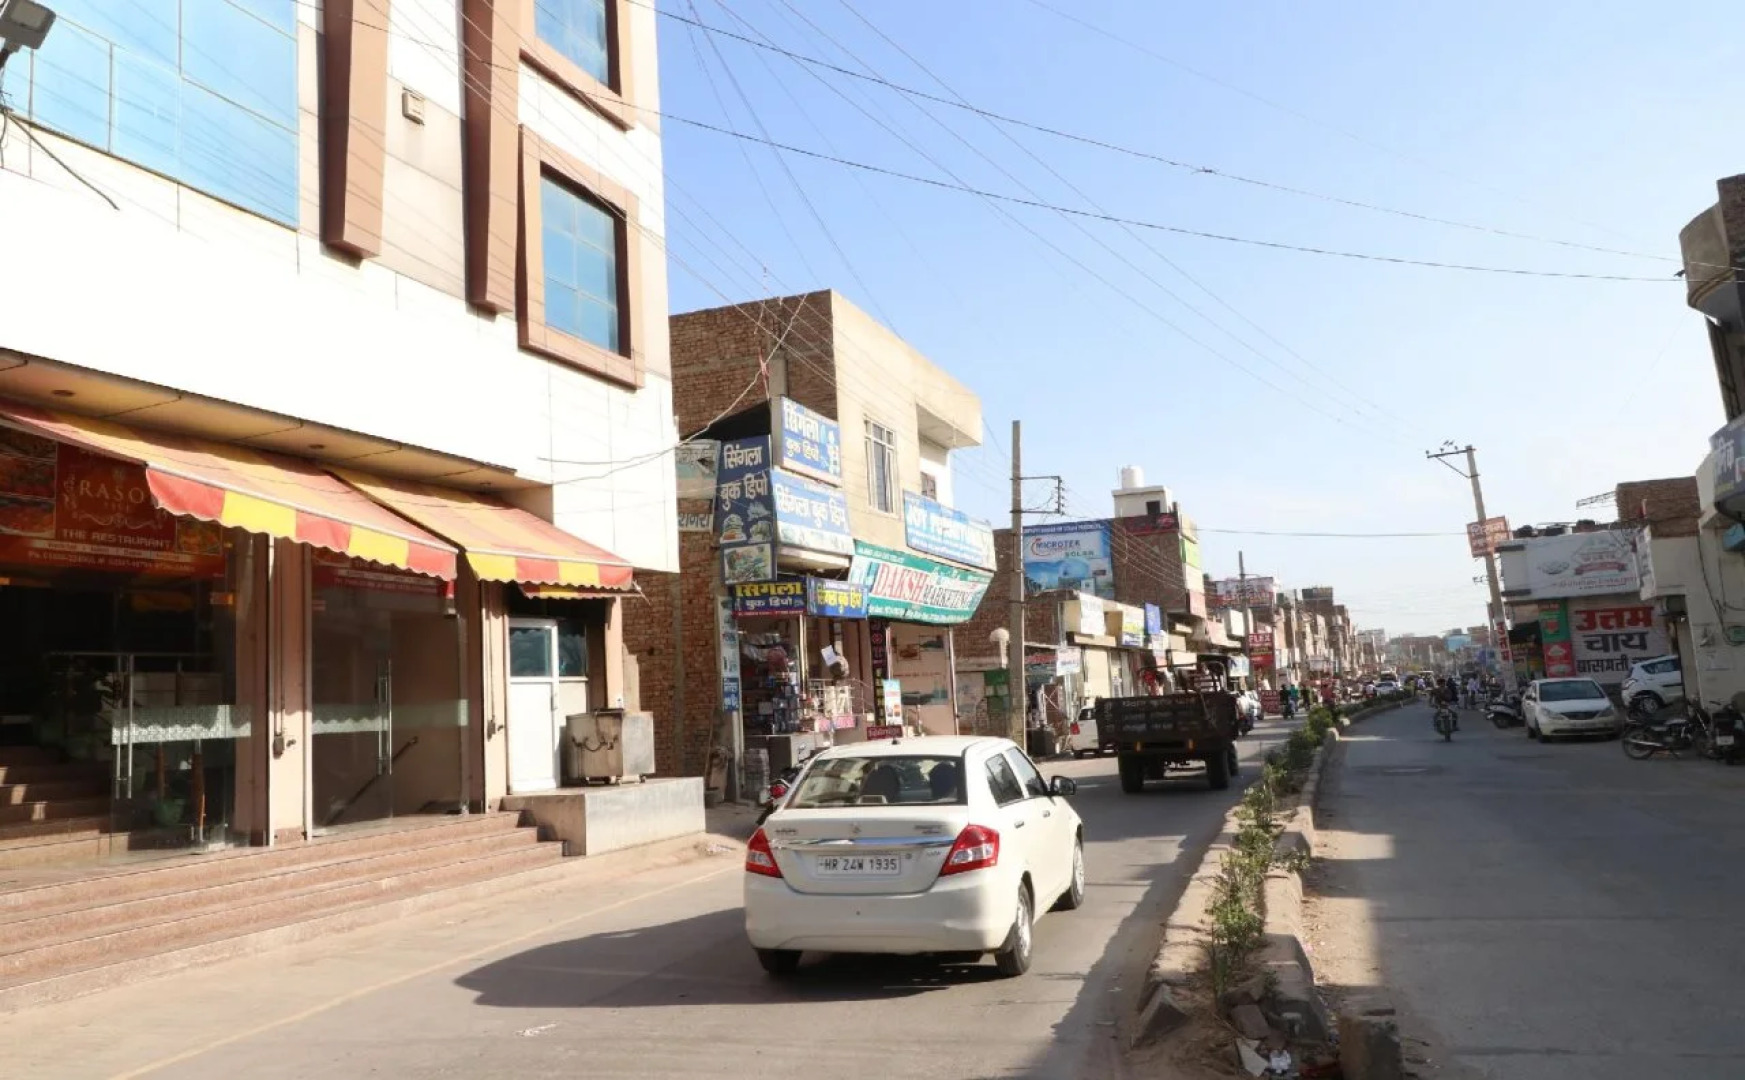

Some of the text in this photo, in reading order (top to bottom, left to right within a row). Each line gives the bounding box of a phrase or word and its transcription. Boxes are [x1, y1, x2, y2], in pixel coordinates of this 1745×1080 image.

[723, 443, 763, 470] सिंगला
[719, 473, 769, 511] बुक डिपो
[91, 531, 172, 550] RESTAURANT
[1036, 539, 1081, 549] MICROTEK
[872, 562, 929, 604] DAKSH
[1582, 631, 1649, 653] चाय
[824, 857, 898, 871] HR 24W 1935
